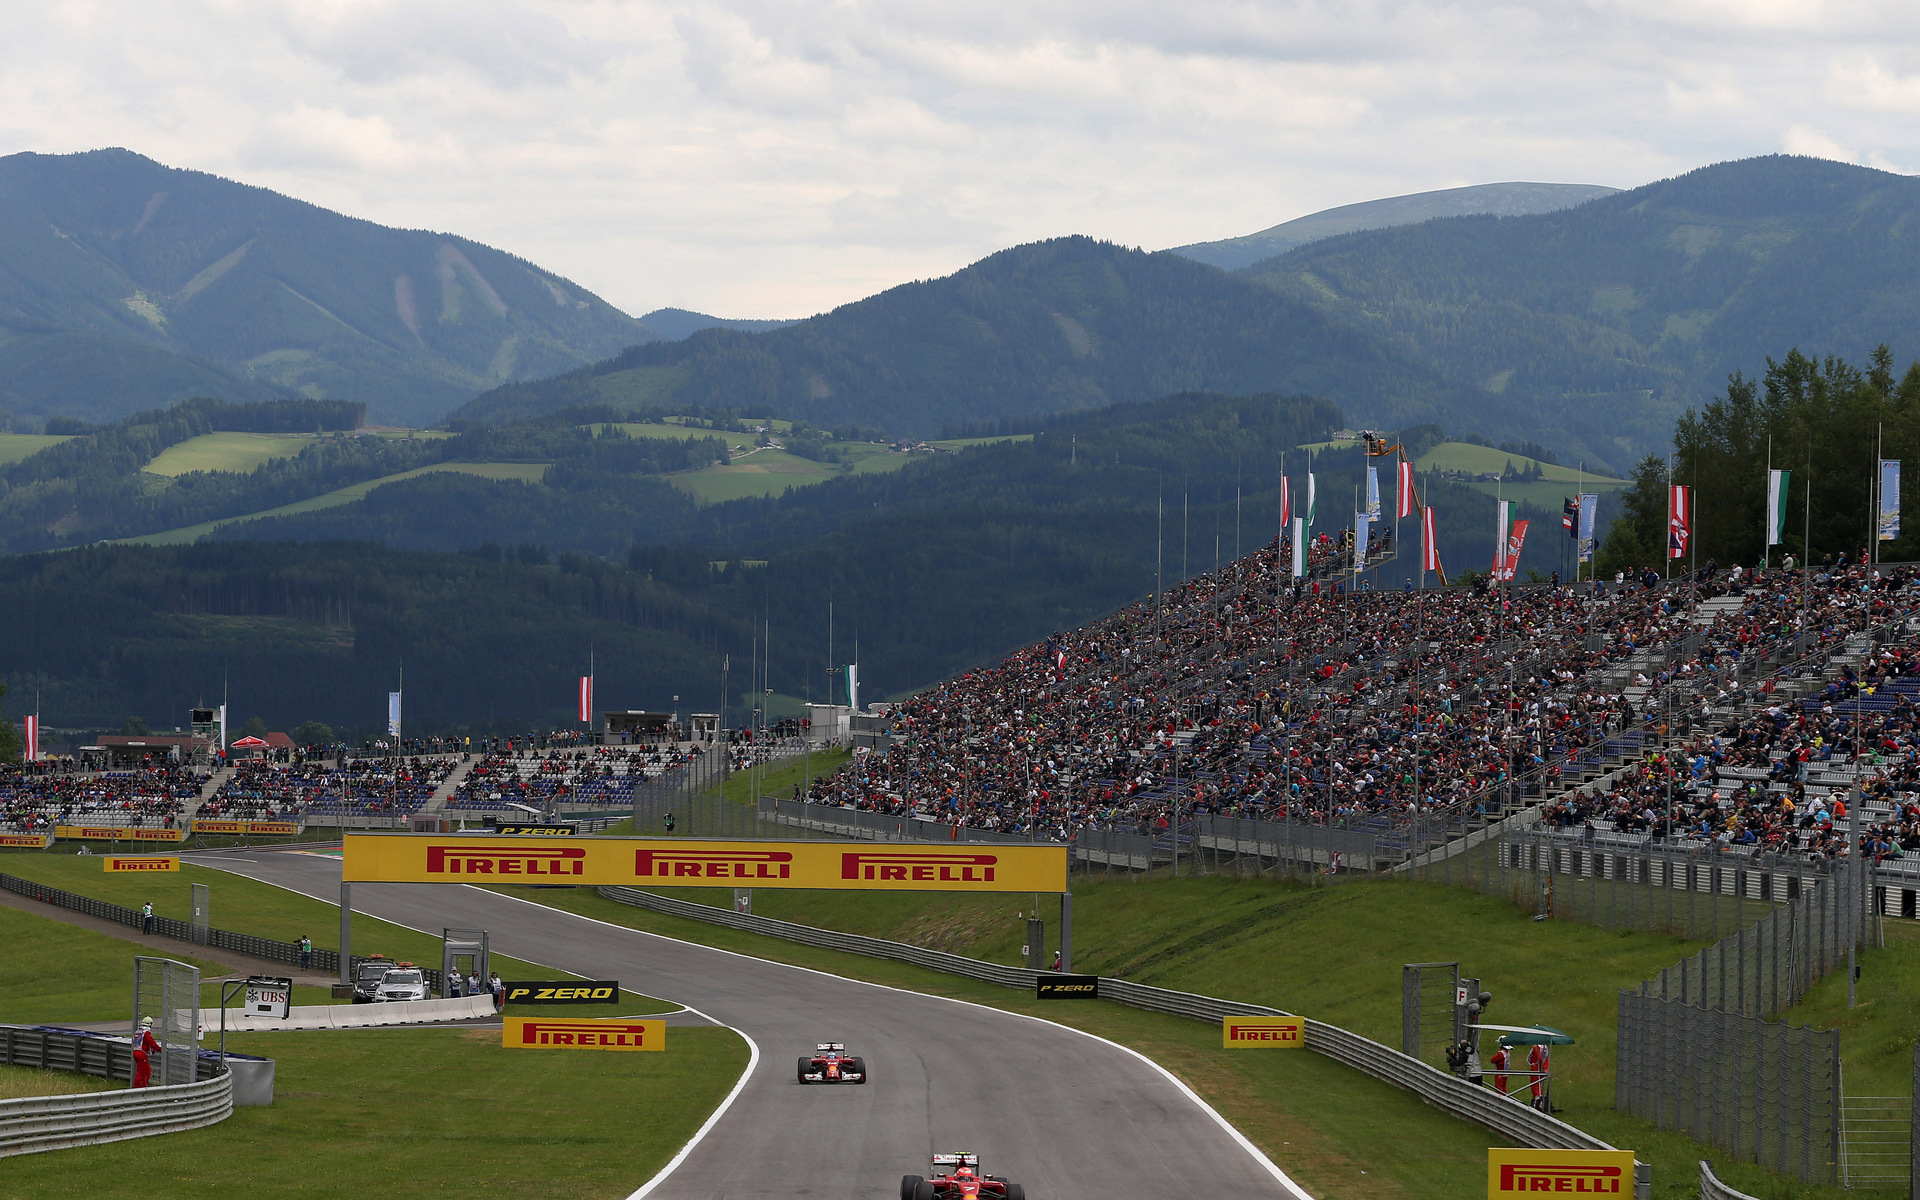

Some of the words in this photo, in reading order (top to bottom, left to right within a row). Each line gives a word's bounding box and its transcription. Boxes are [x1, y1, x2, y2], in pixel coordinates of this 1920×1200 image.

[198, 822, 238, 831] PIRELLI
[251, 823, 292, 832] PIRELLI
[82, 829, 123, 838] PIRELLI
[136, 830, 176, 839] PIRELLI
[0, 836, 40, 846] PIRELLI
[113, 860, 170, 870] PIRELLI
[427, 846, 586, 875] PIRELLI
[635, 849, 793, 878] PIRELLI
[841, 853, 998, 882] PIRELLI
[261, 991, 285, 1003] UBS
[509, 988, 530, 999] P
[535, 988, 613, 999] ZERO
[1459, 991, 1465, 1001] F
[522, 1023, 645, 1046] PIRELLI
[1230, 1025, 1297, 1040] PIRELLI
[1500, 1164, 1621, 1193] PIRELLI
